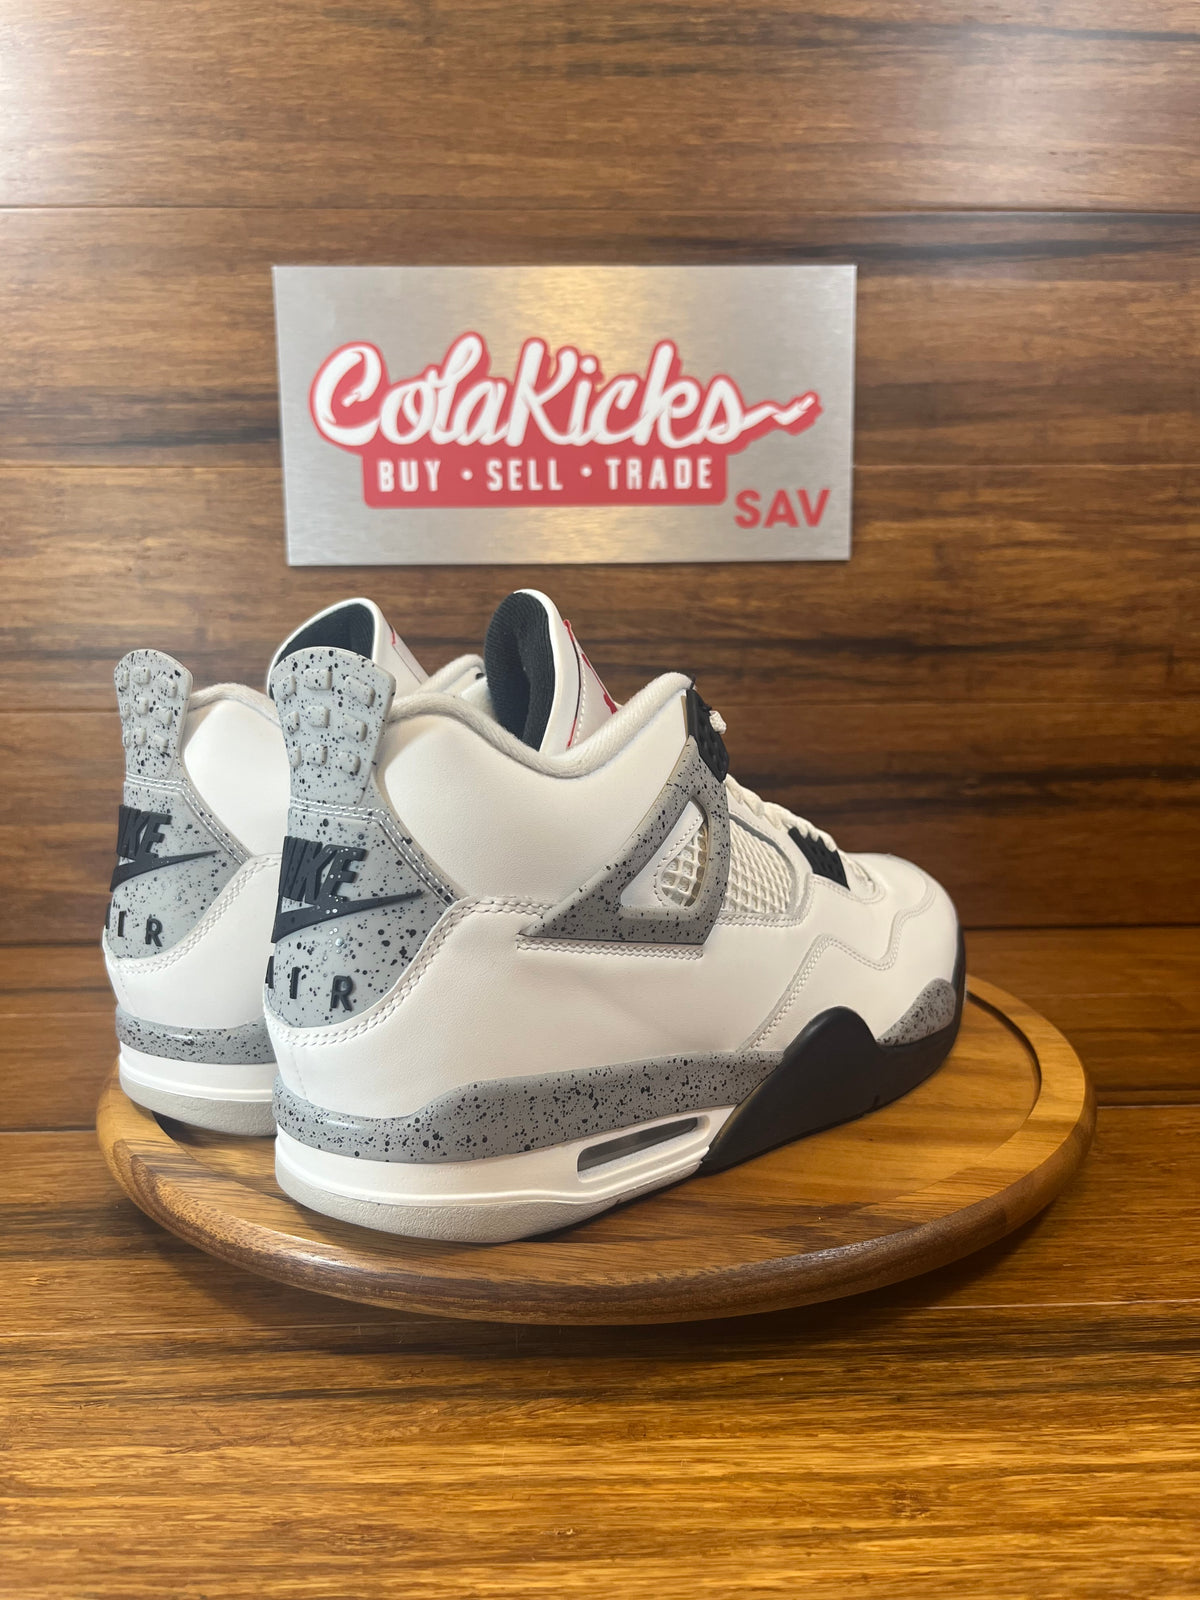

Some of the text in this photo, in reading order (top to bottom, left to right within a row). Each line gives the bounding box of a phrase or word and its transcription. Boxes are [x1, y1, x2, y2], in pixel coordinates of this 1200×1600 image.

[311, 333, 822, 448] ColaKicks
[378, 457, 713, 492] BUY SELL TRADE
[734, 489, 830, 529] SAV
